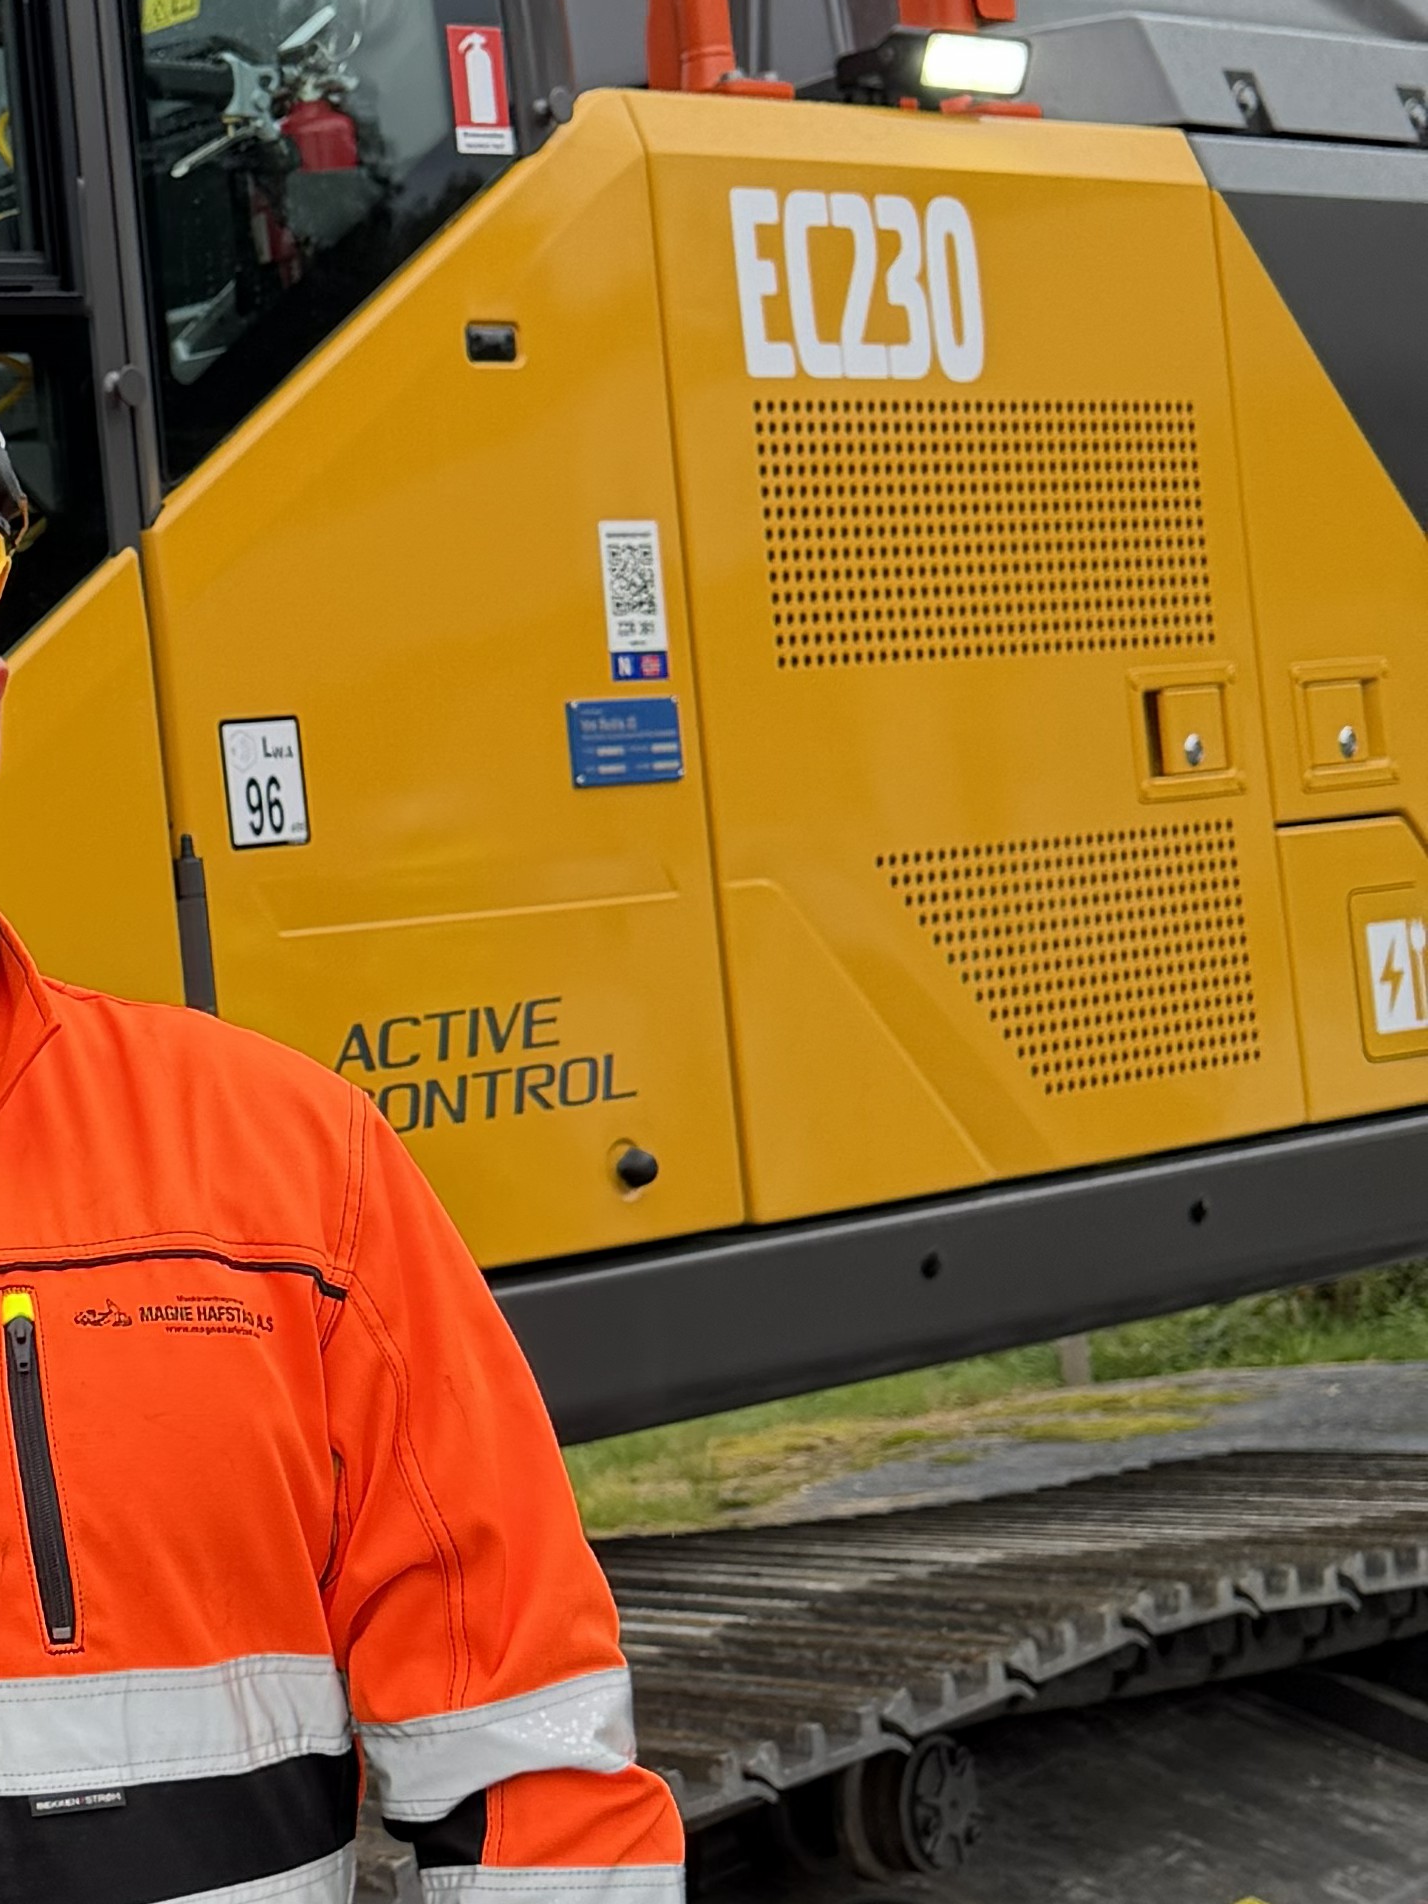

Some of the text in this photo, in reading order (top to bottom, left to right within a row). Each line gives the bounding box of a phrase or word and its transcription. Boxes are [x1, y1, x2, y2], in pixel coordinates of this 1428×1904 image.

[729, 186, 984, 383] EC230
[245, 775, 285, 837] 96
[334, 996, 562, 1073] ACTIVE
[363, 1053, 638, 1135] ONTROL
[139, 1305, 194, 1323] MAGNE
